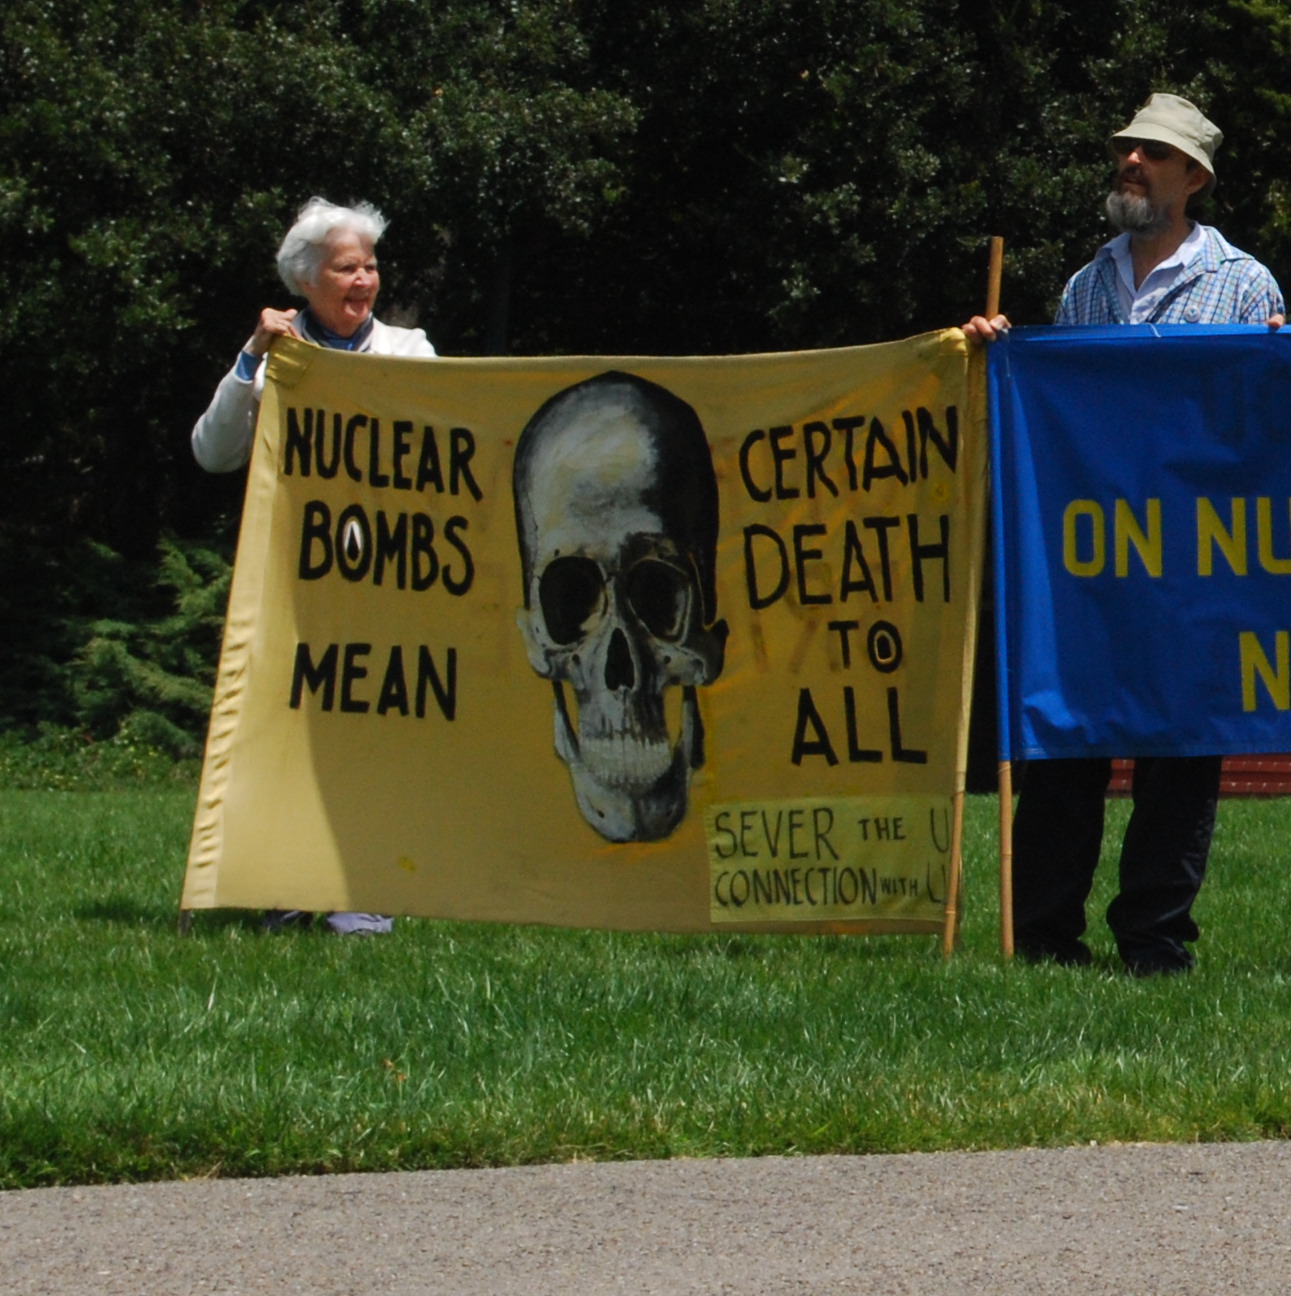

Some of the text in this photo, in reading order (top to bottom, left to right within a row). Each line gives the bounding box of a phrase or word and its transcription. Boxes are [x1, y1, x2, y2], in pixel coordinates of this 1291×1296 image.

[284, 407, 484, 502] NUCLEAR
[739, 405, 959, 503] CERTAIN
[299, 500, 475, 596] BOMBS
[743, 513, 951, 610] DEATH
[1062, 498, 1163, 578] ON
[289, 642, 458, 722] MEAN
[828, 620, 902, 674] TO
[791, 686, 928, 767] ALL
[714, 807, 839, 859] SEVER
[858, 816, 907, 842] THE
[714, 866, 877, 906] CONNECTION
[880, 876, 919, 897] WITH
